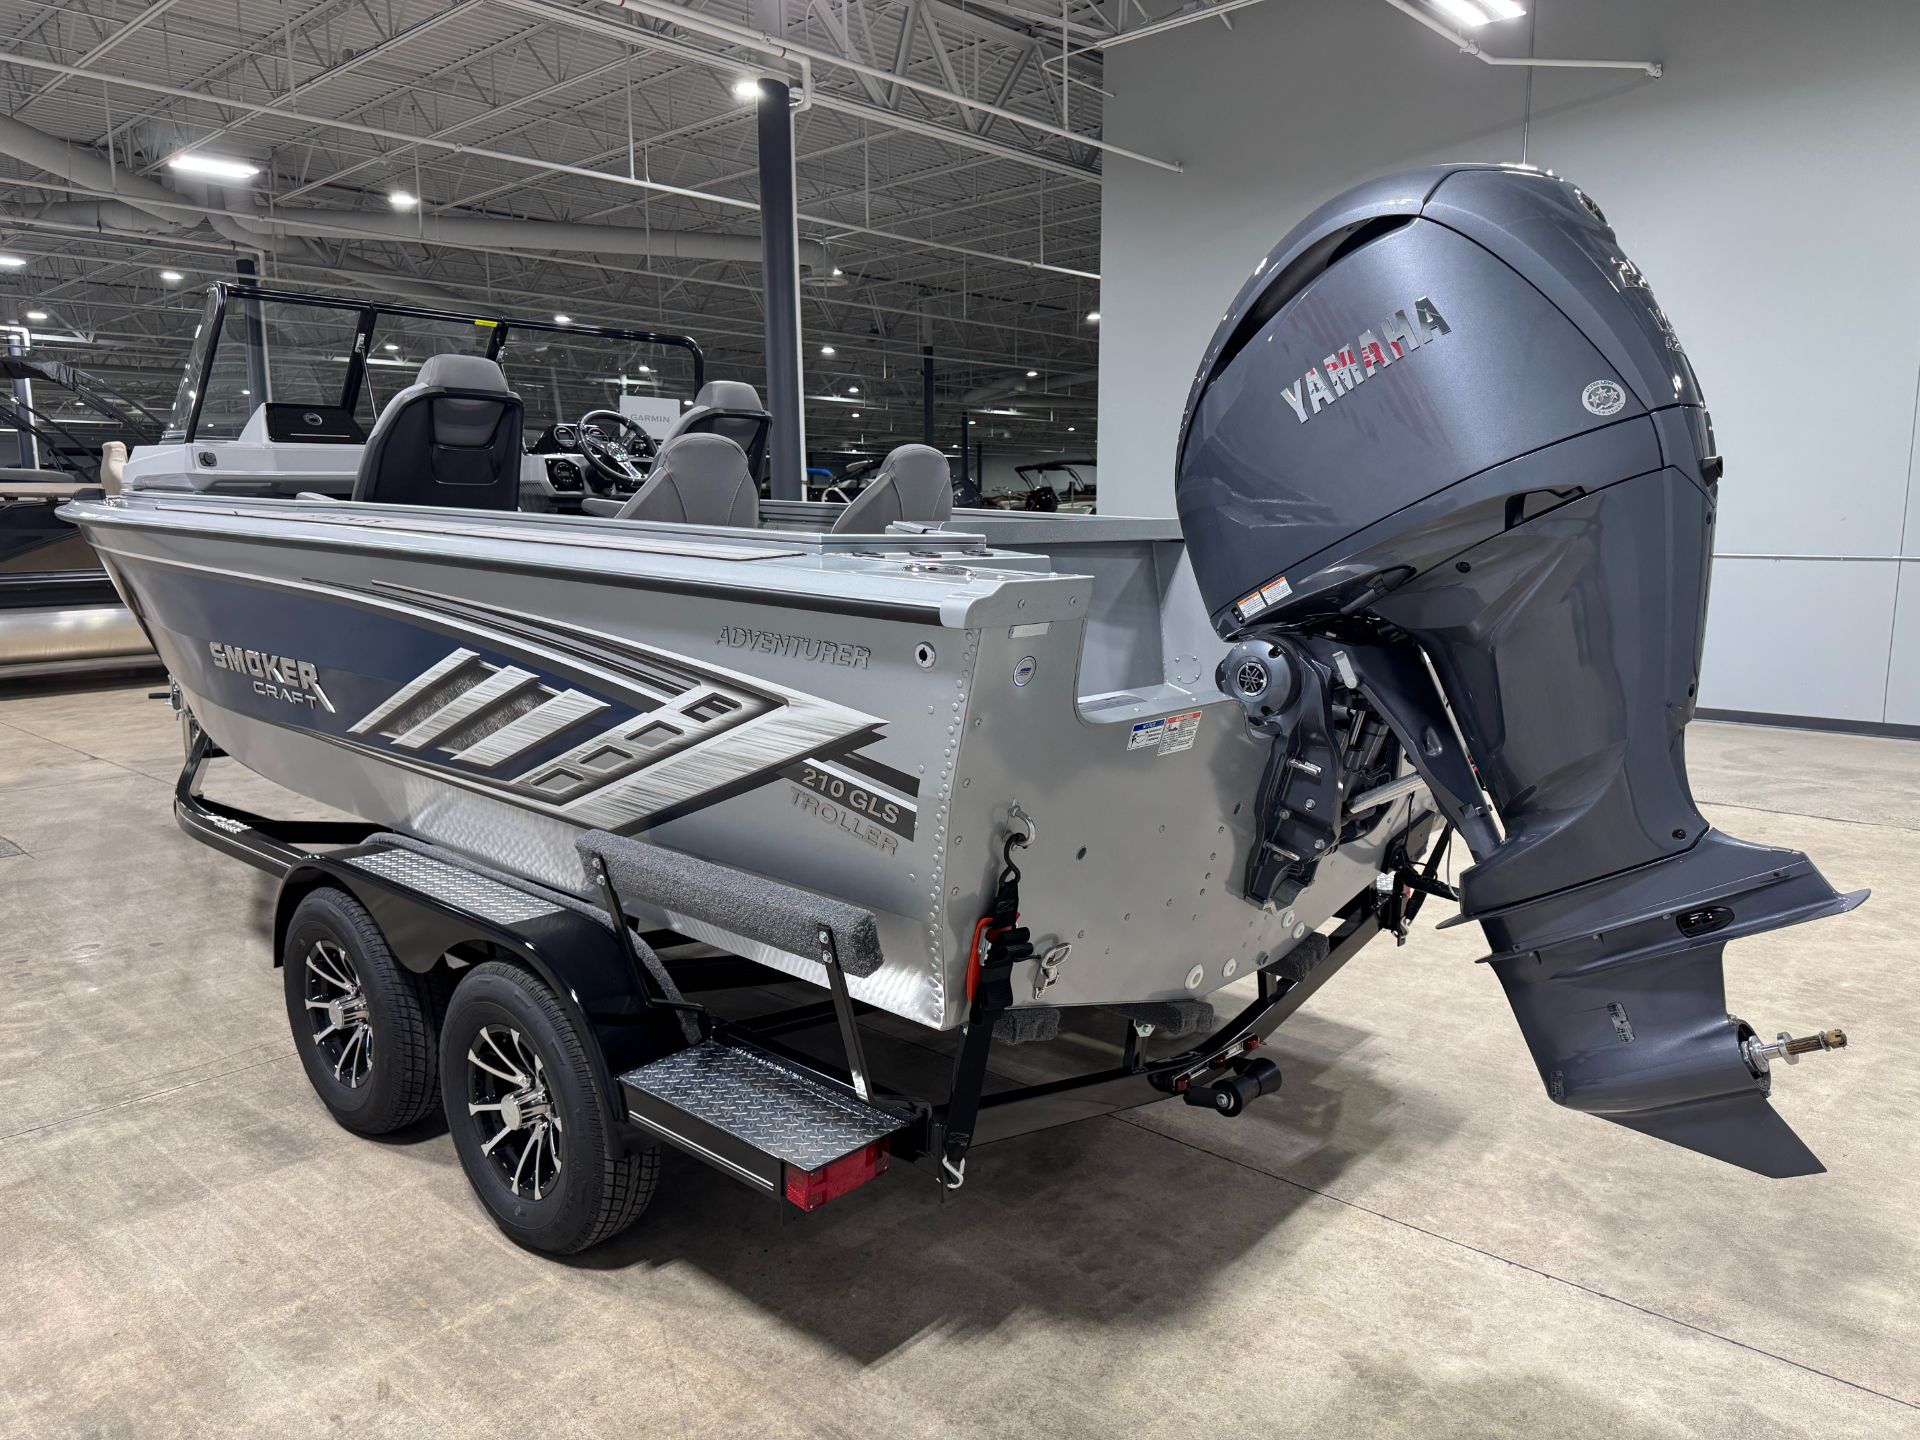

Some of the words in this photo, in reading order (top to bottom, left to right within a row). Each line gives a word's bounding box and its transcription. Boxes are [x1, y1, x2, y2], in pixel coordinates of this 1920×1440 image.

[1280, 296, 1451, 424] YAMAHA
[630, 413, 671, 423] GARMIN
[716, 626, 871, 669] ADVENTURER
[209, 641, 335, 713] SMOKER
[253, 681, 317, 709] CRAFT
[790, 786, 899, 856] TROLLER
[802, 768, 845, 798] 210
[849, 789, 900, 824] GLS
